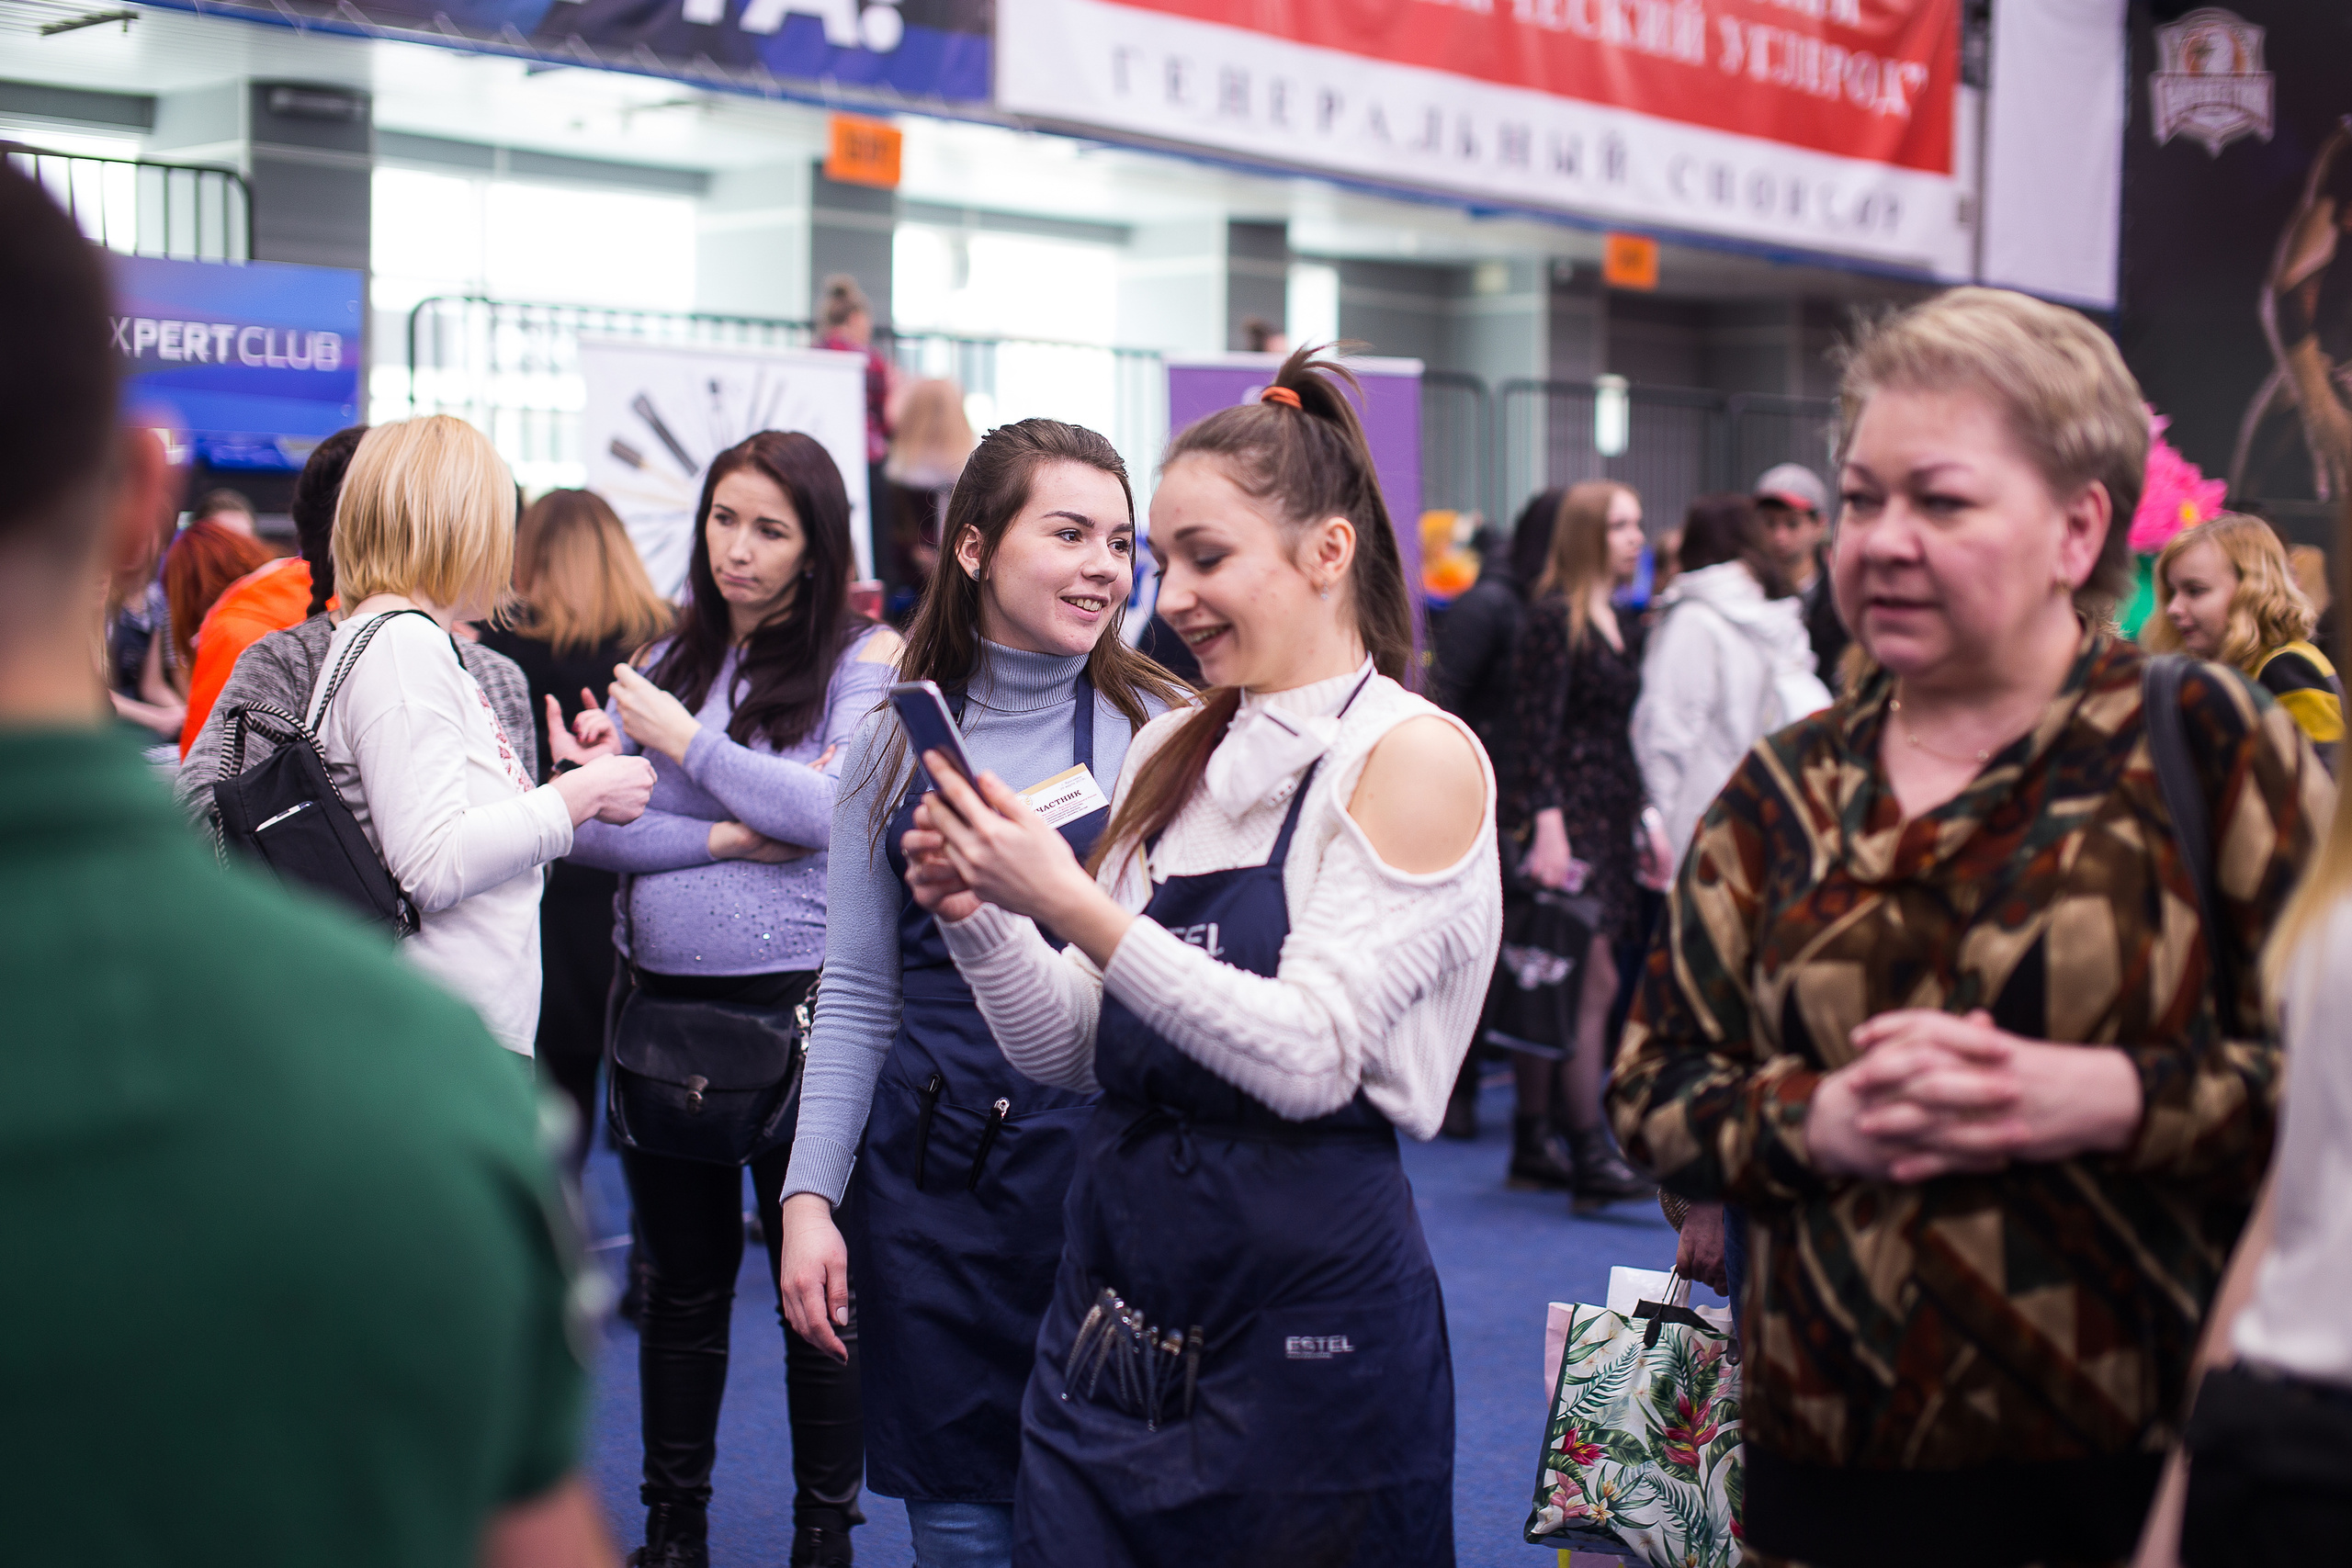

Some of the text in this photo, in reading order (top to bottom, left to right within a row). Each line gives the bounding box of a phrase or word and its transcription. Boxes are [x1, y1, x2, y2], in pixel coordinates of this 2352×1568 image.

[1110, 43, 1630, 187] ГЕНЕРАЛЬНЫЙ
[107, 316, 343, 372] XPERTCLUB
[1034, 789, 1082, 814] ЧАСТНИК
[1285, 1335, 1355, 1354] ESTEL
